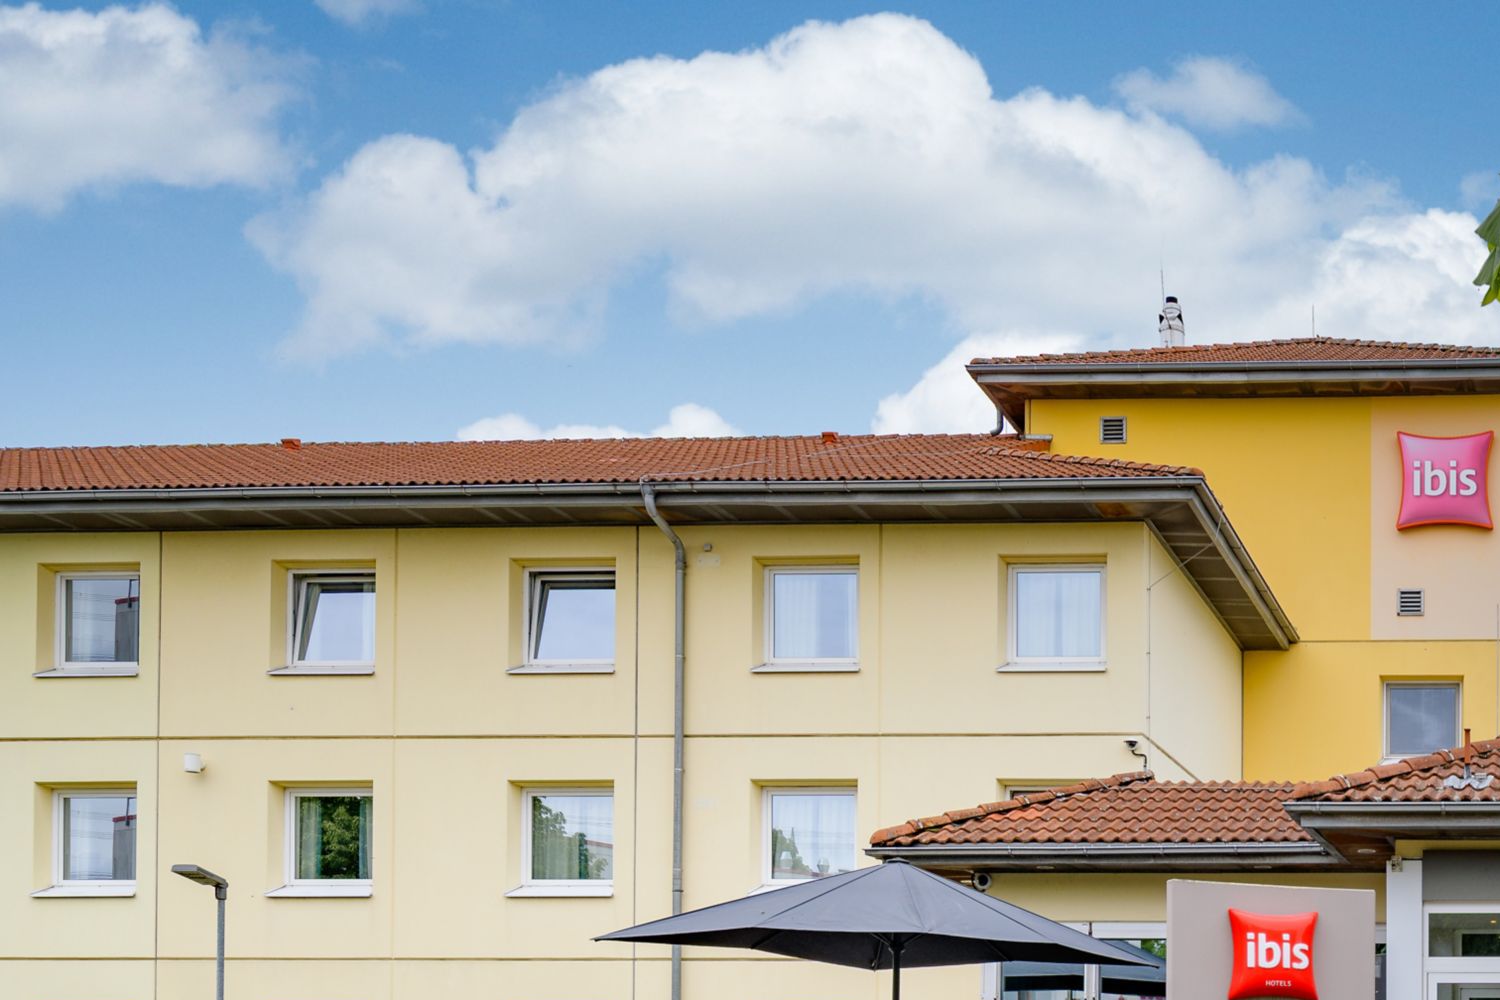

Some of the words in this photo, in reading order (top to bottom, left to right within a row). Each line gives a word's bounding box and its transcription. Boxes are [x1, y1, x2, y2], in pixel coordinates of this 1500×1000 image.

[1412, 460, 1478, 496] ibis
[1246, 931, 1310, 970] ibis
[1265, 979, 1292, 987] HOTELS
